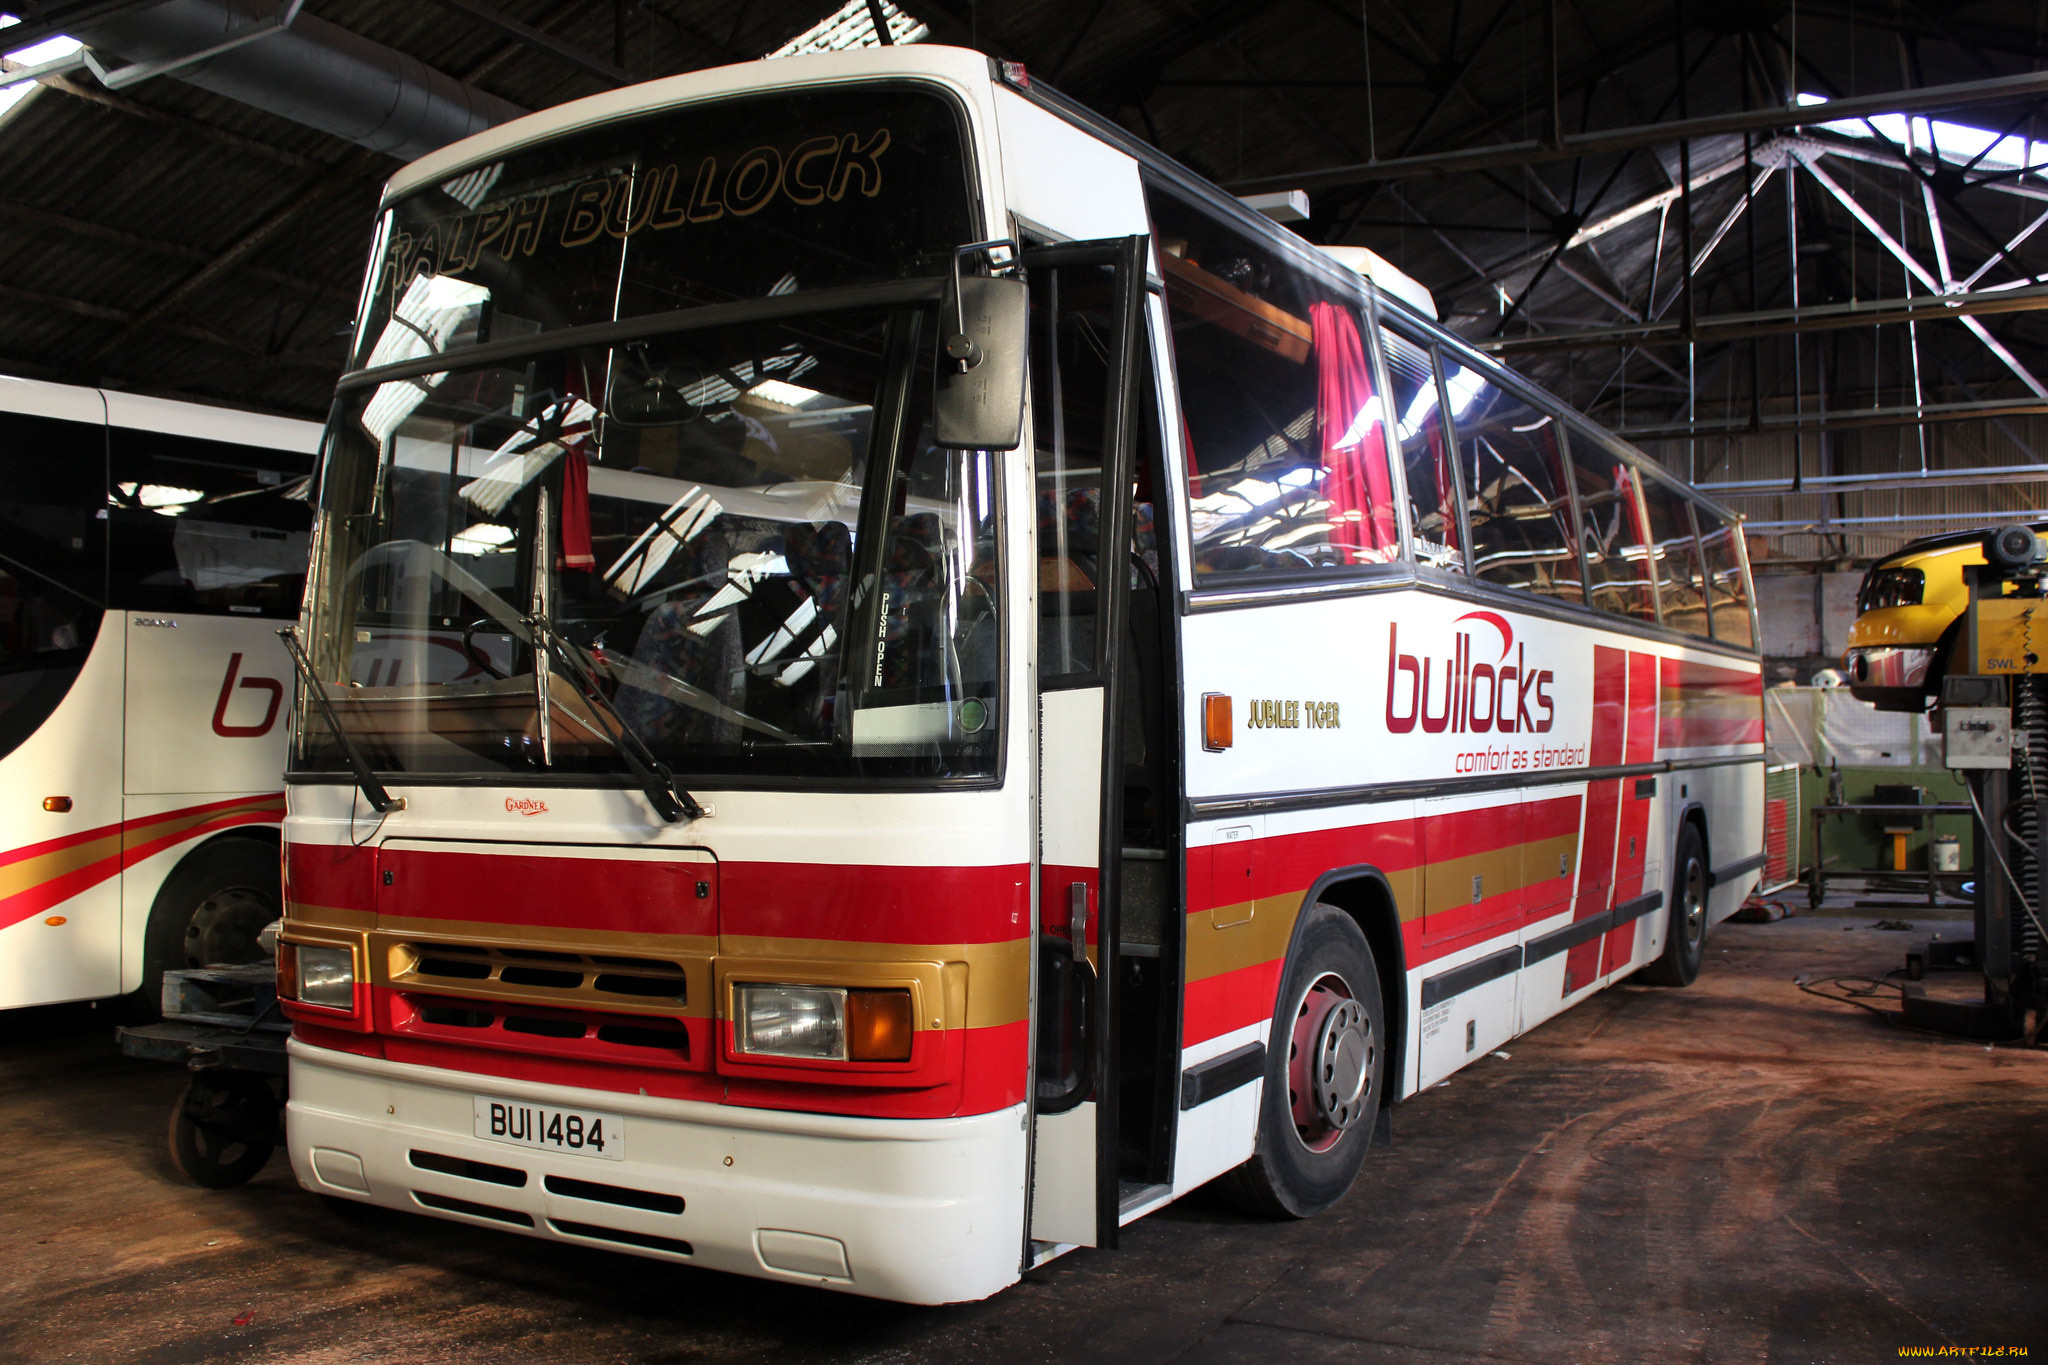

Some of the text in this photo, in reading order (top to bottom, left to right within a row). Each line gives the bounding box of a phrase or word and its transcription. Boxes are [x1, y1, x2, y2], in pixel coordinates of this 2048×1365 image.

[375, 128, 891, 296] RALPH BULLOCK
[874, 592, 890, 687] PUSH OPEN
[1987, 658, 2018, 669] SWL
[1386, 621, 1554, 734] bullocks
[1248, 699, 1340, 729] JUBILEE TIGER
[1456, 742, 1586, 773] comfort as standard
